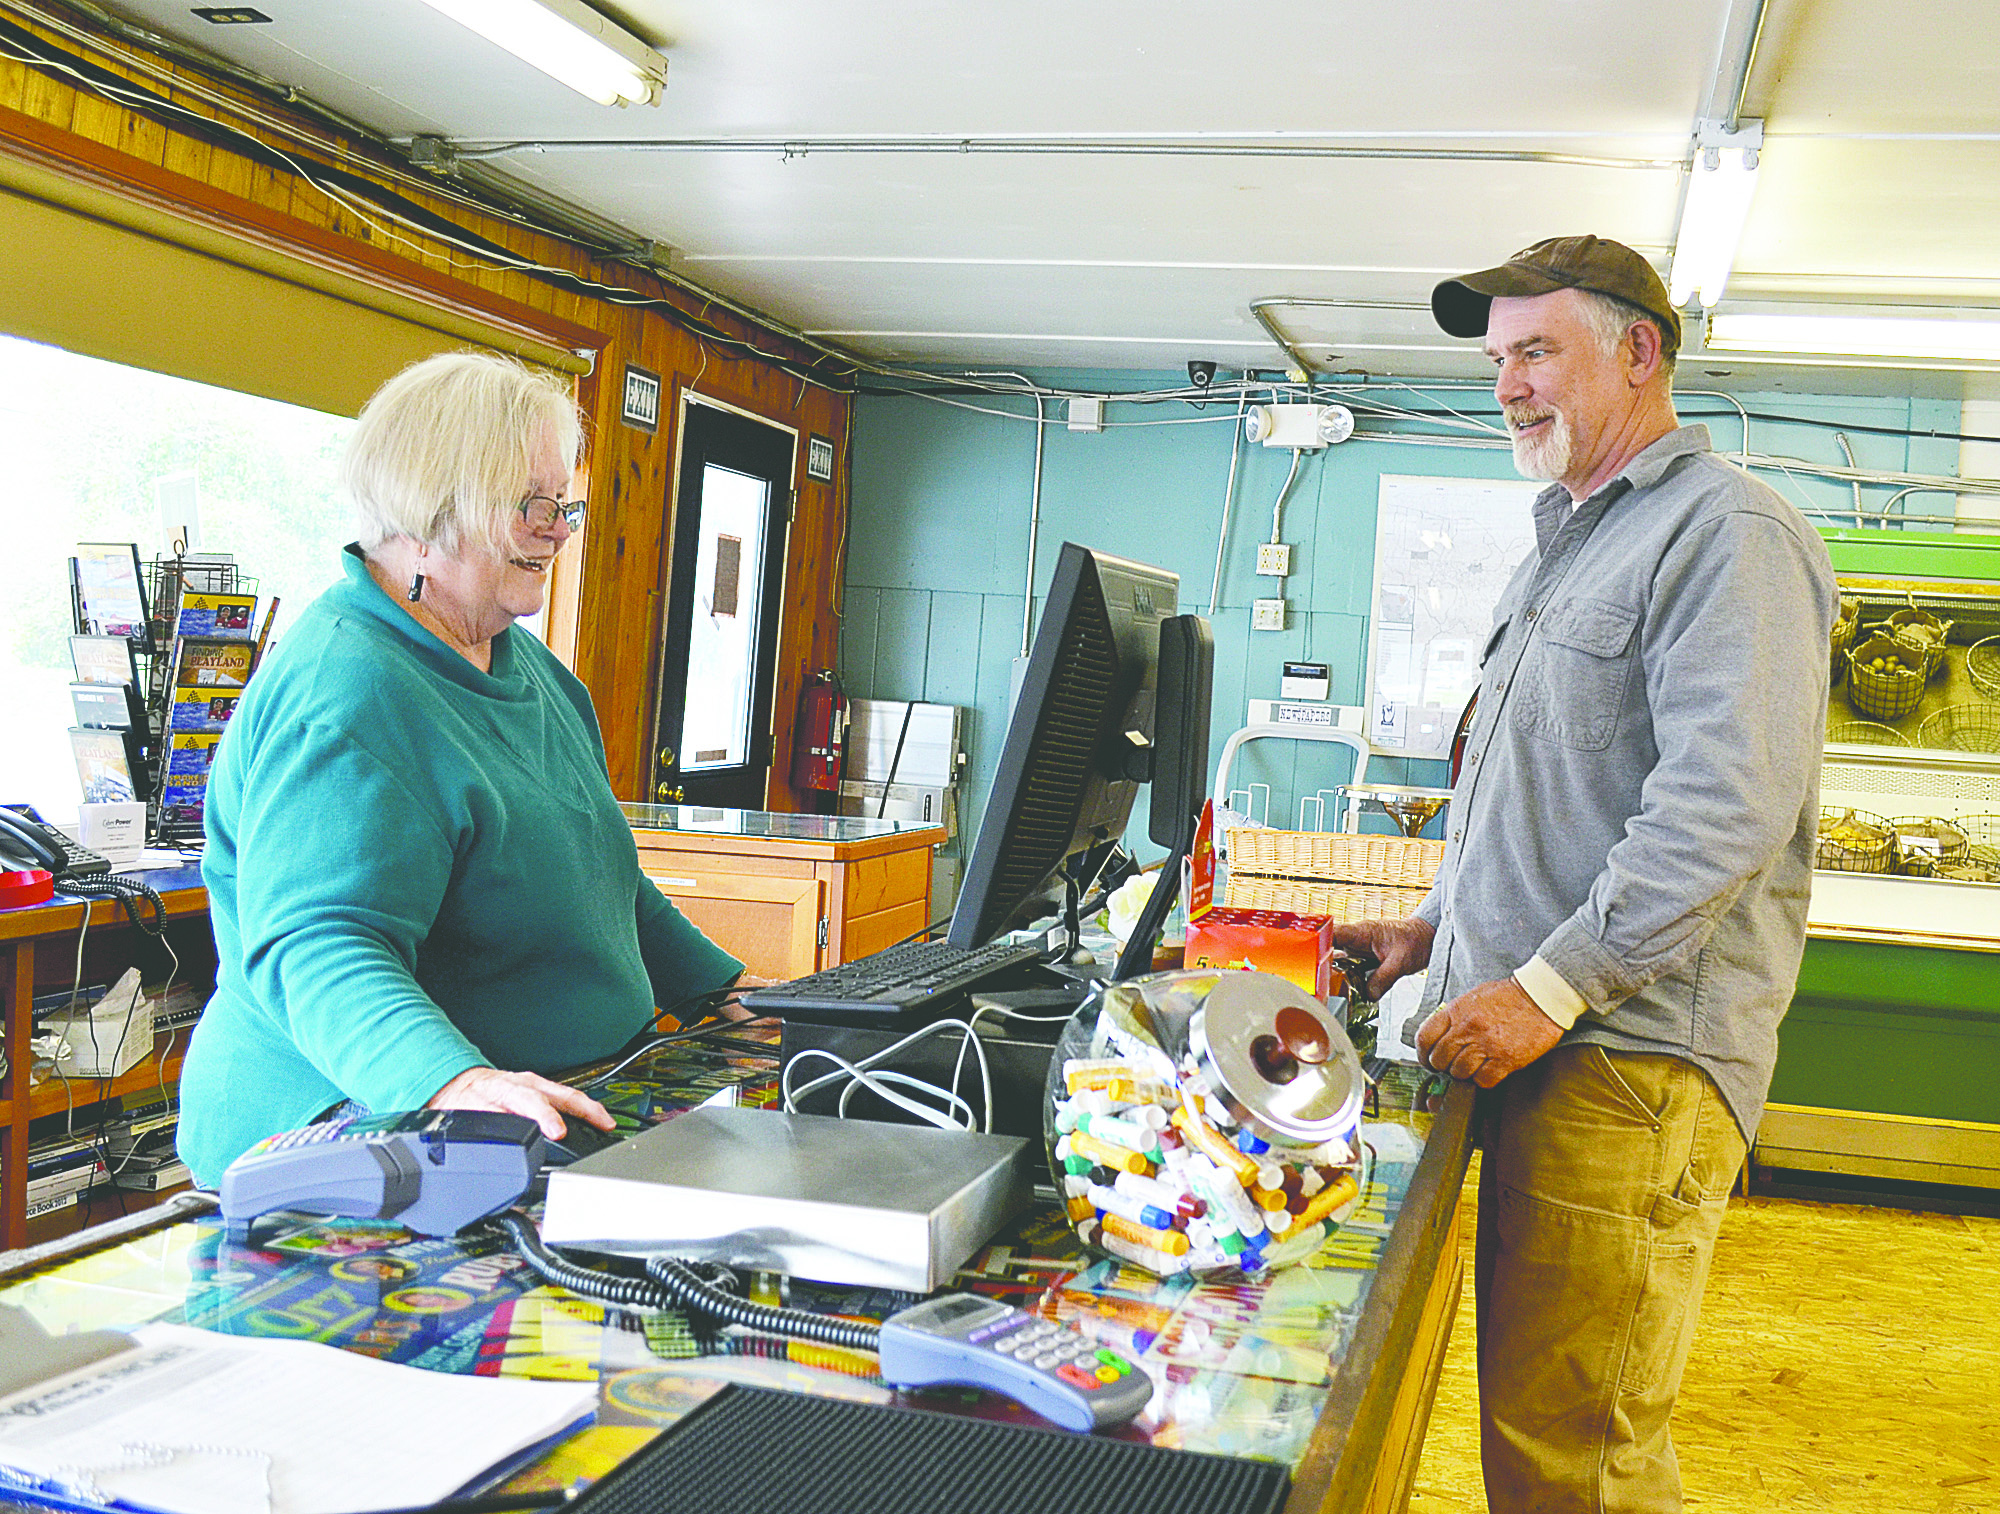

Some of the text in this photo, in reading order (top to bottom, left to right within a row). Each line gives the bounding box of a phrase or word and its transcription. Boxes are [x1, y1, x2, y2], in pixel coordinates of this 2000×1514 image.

[628, 375, 656, 421] EXIT
[809, 441, 832, 476] EXIT
[191, 647, 224, 658] FINDING
[190, 656, 245, 667] PLAYLAND
[1280, 707, 1330, 722] NEWSPAPERS
[37, 1200, 53, 1213] Book
